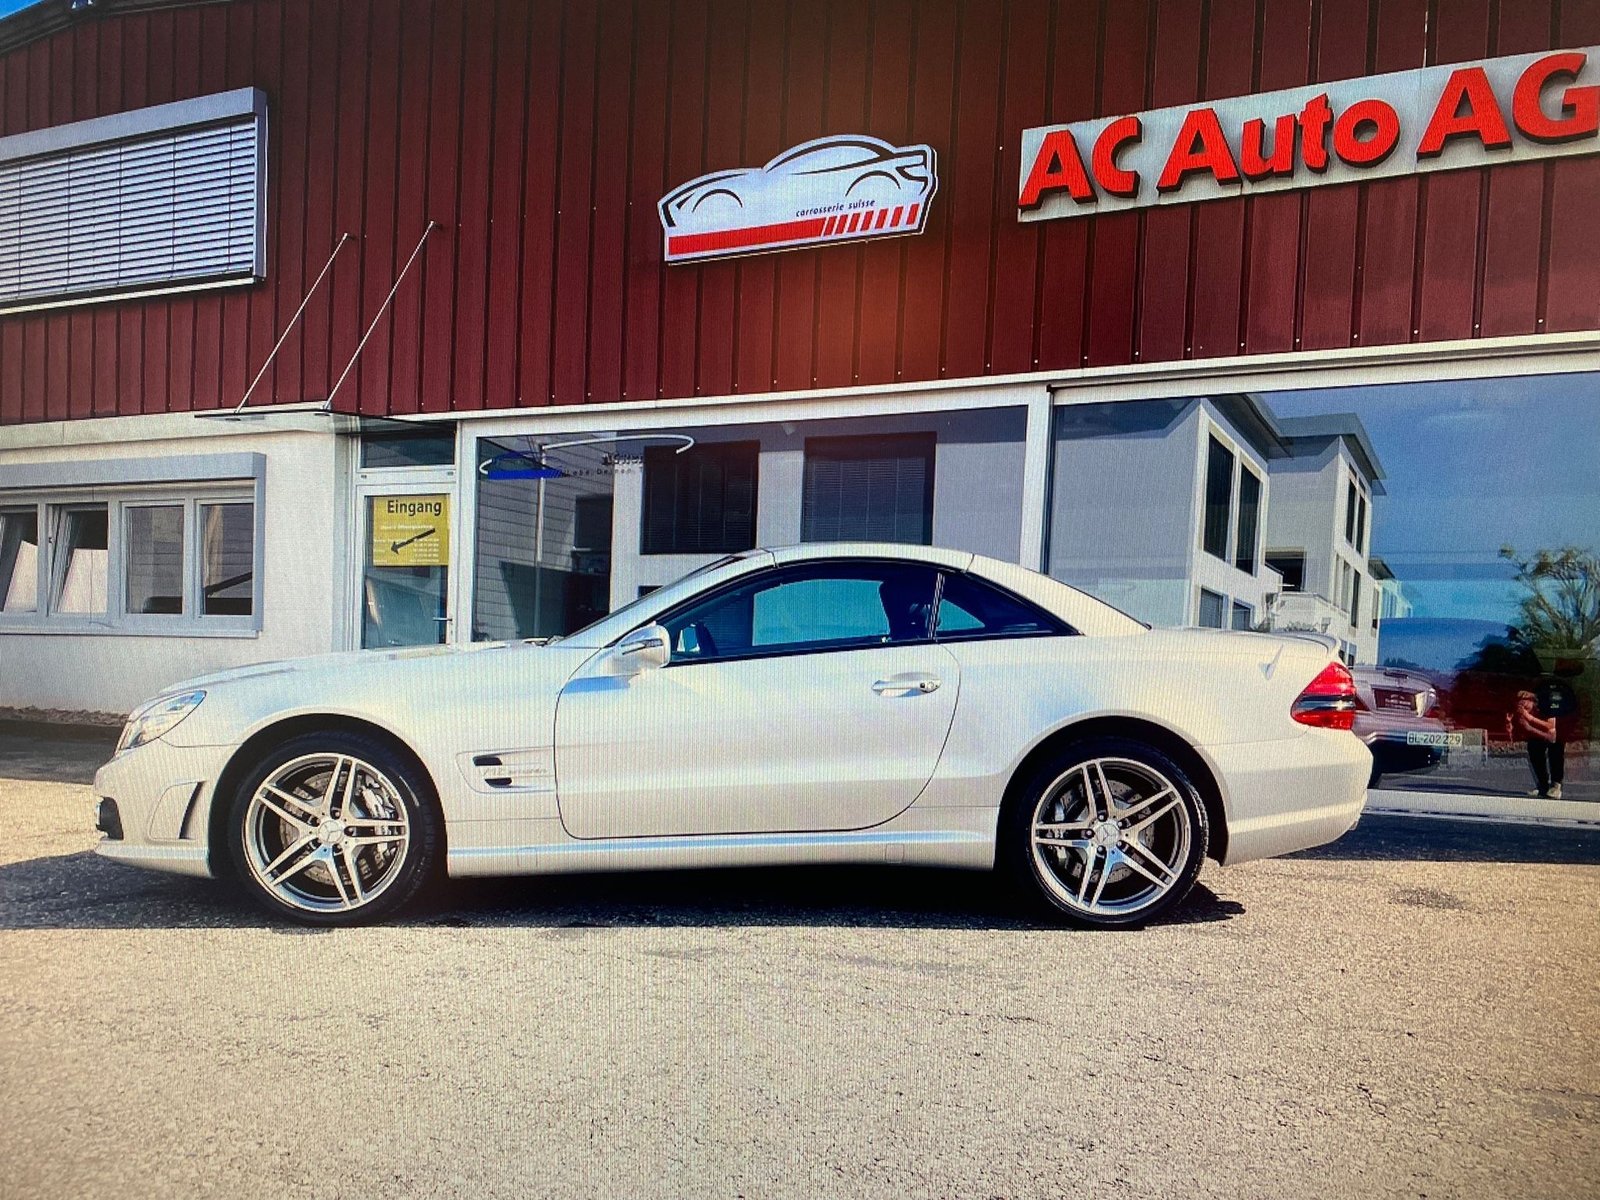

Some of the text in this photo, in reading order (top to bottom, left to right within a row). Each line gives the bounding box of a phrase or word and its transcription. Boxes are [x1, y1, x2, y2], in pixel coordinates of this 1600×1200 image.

[1017, 52, 1600, 209] AC Auto AG
[796, 199, 876, 217] carrosserie suisse
[387, 500, 442, 517] Eingang
